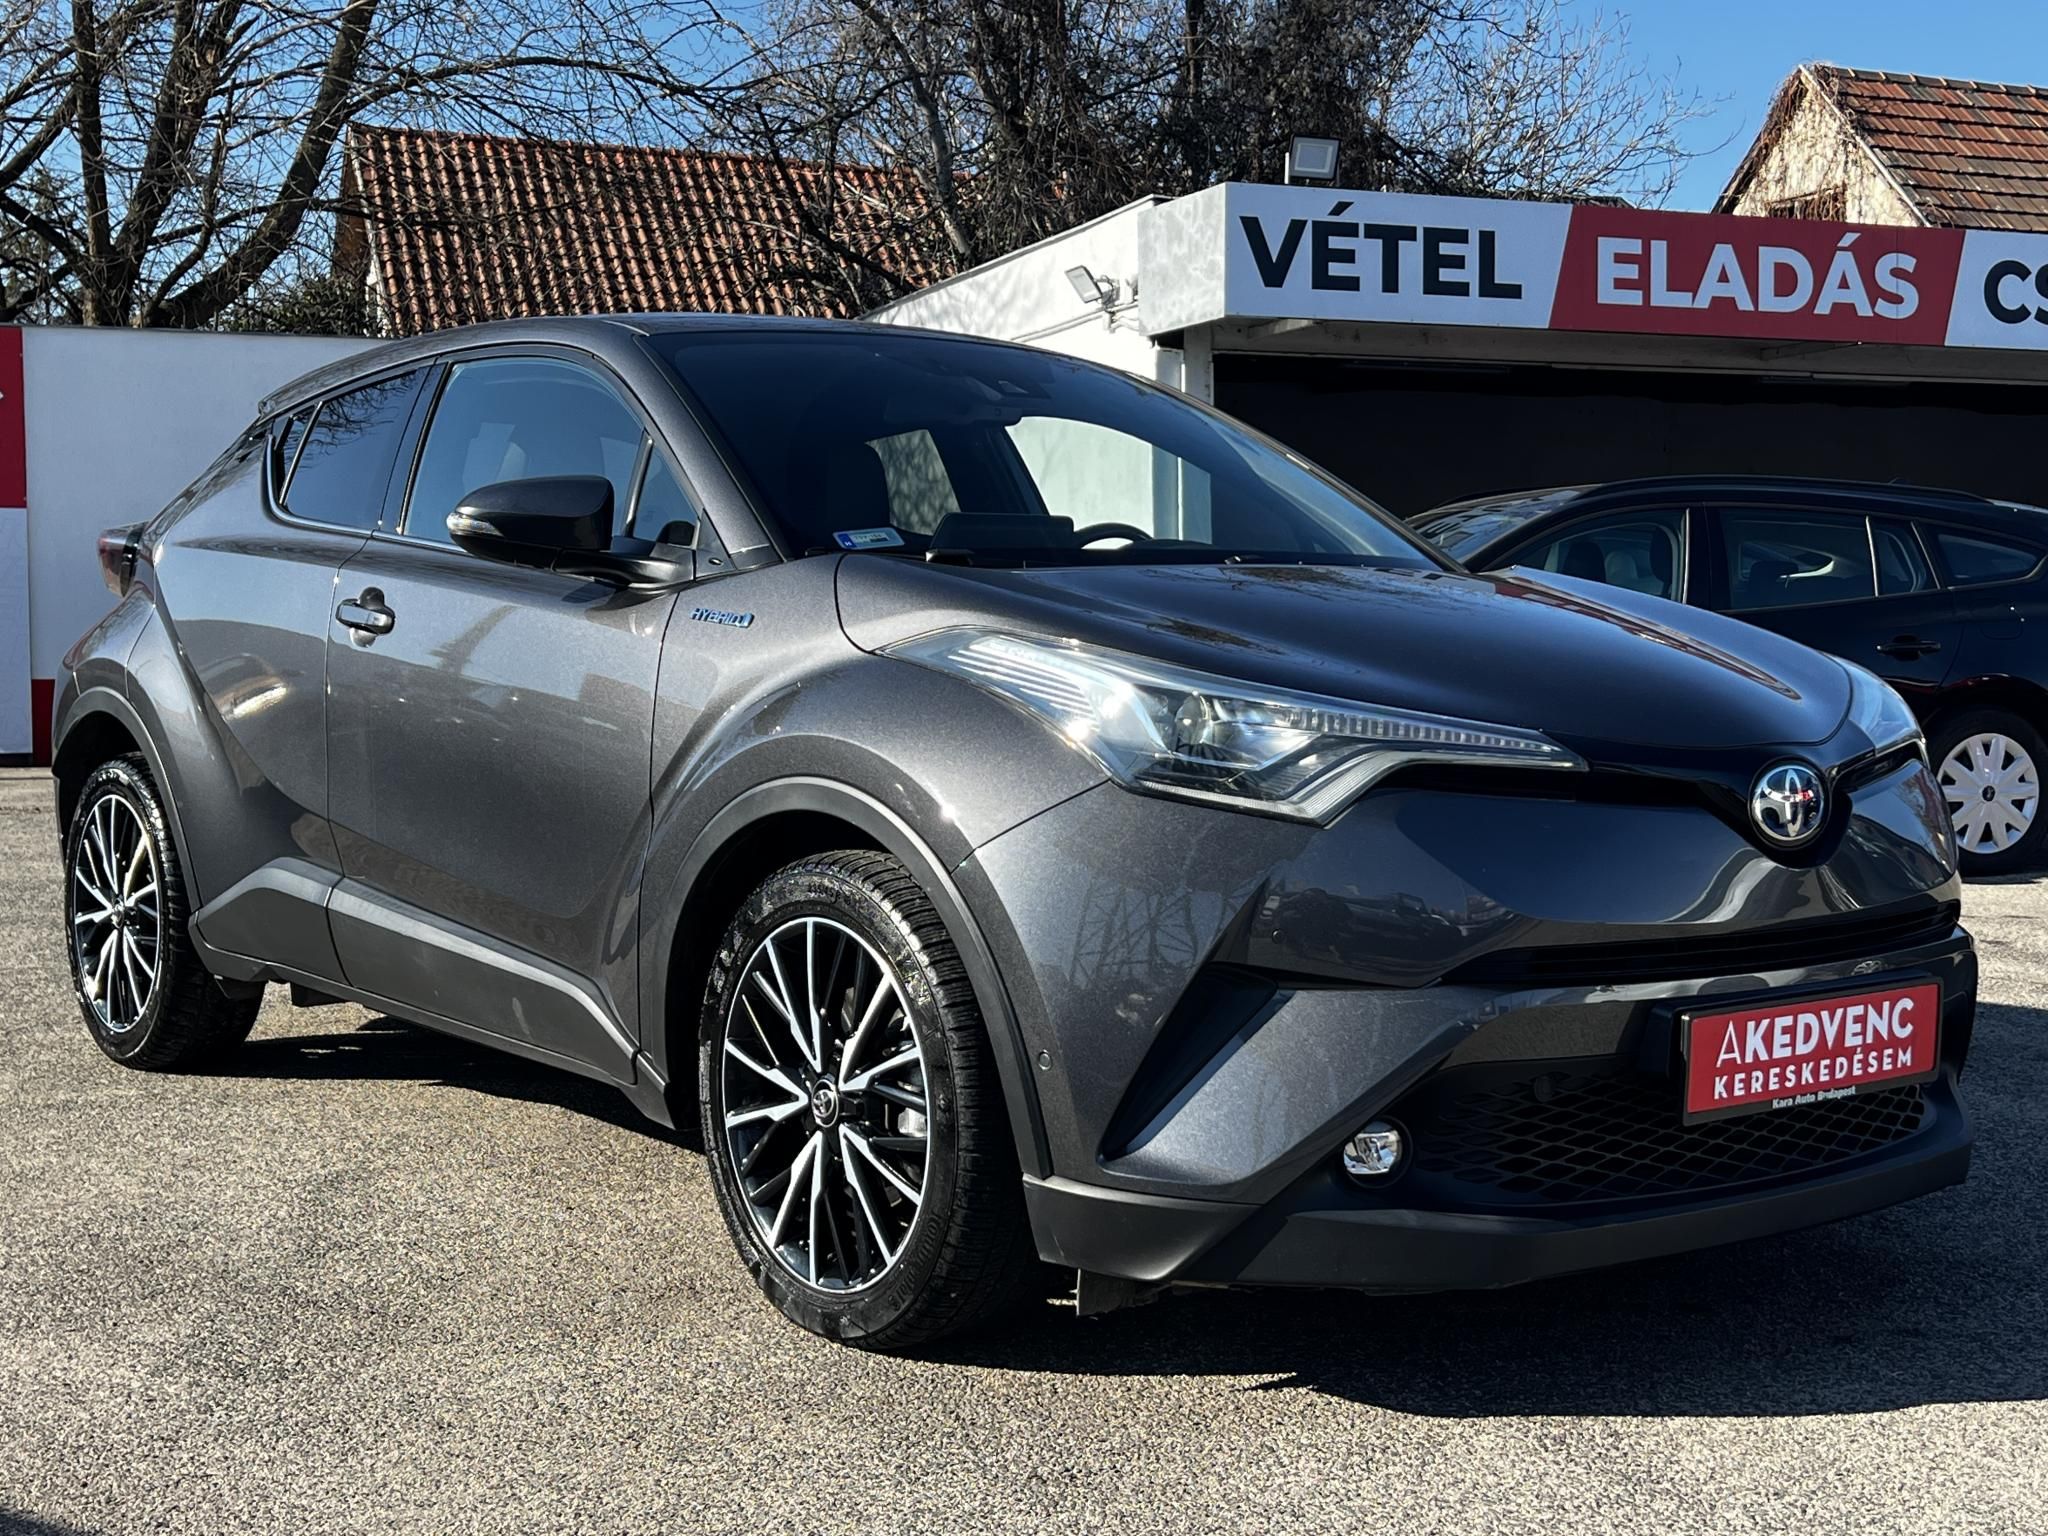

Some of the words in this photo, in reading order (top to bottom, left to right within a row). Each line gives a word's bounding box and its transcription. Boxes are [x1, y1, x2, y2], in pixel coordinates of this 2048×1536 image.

[1239, 201, 1523, 301] VÉTEL
[1596, 232, 1920, 321] ELADÁS
[690, 607, 743, 626] HYBRID
[1714, 1046, 1912, 1100] KERESKEDÉSEM
[1795, 1093, 1815, 1105] Auto
